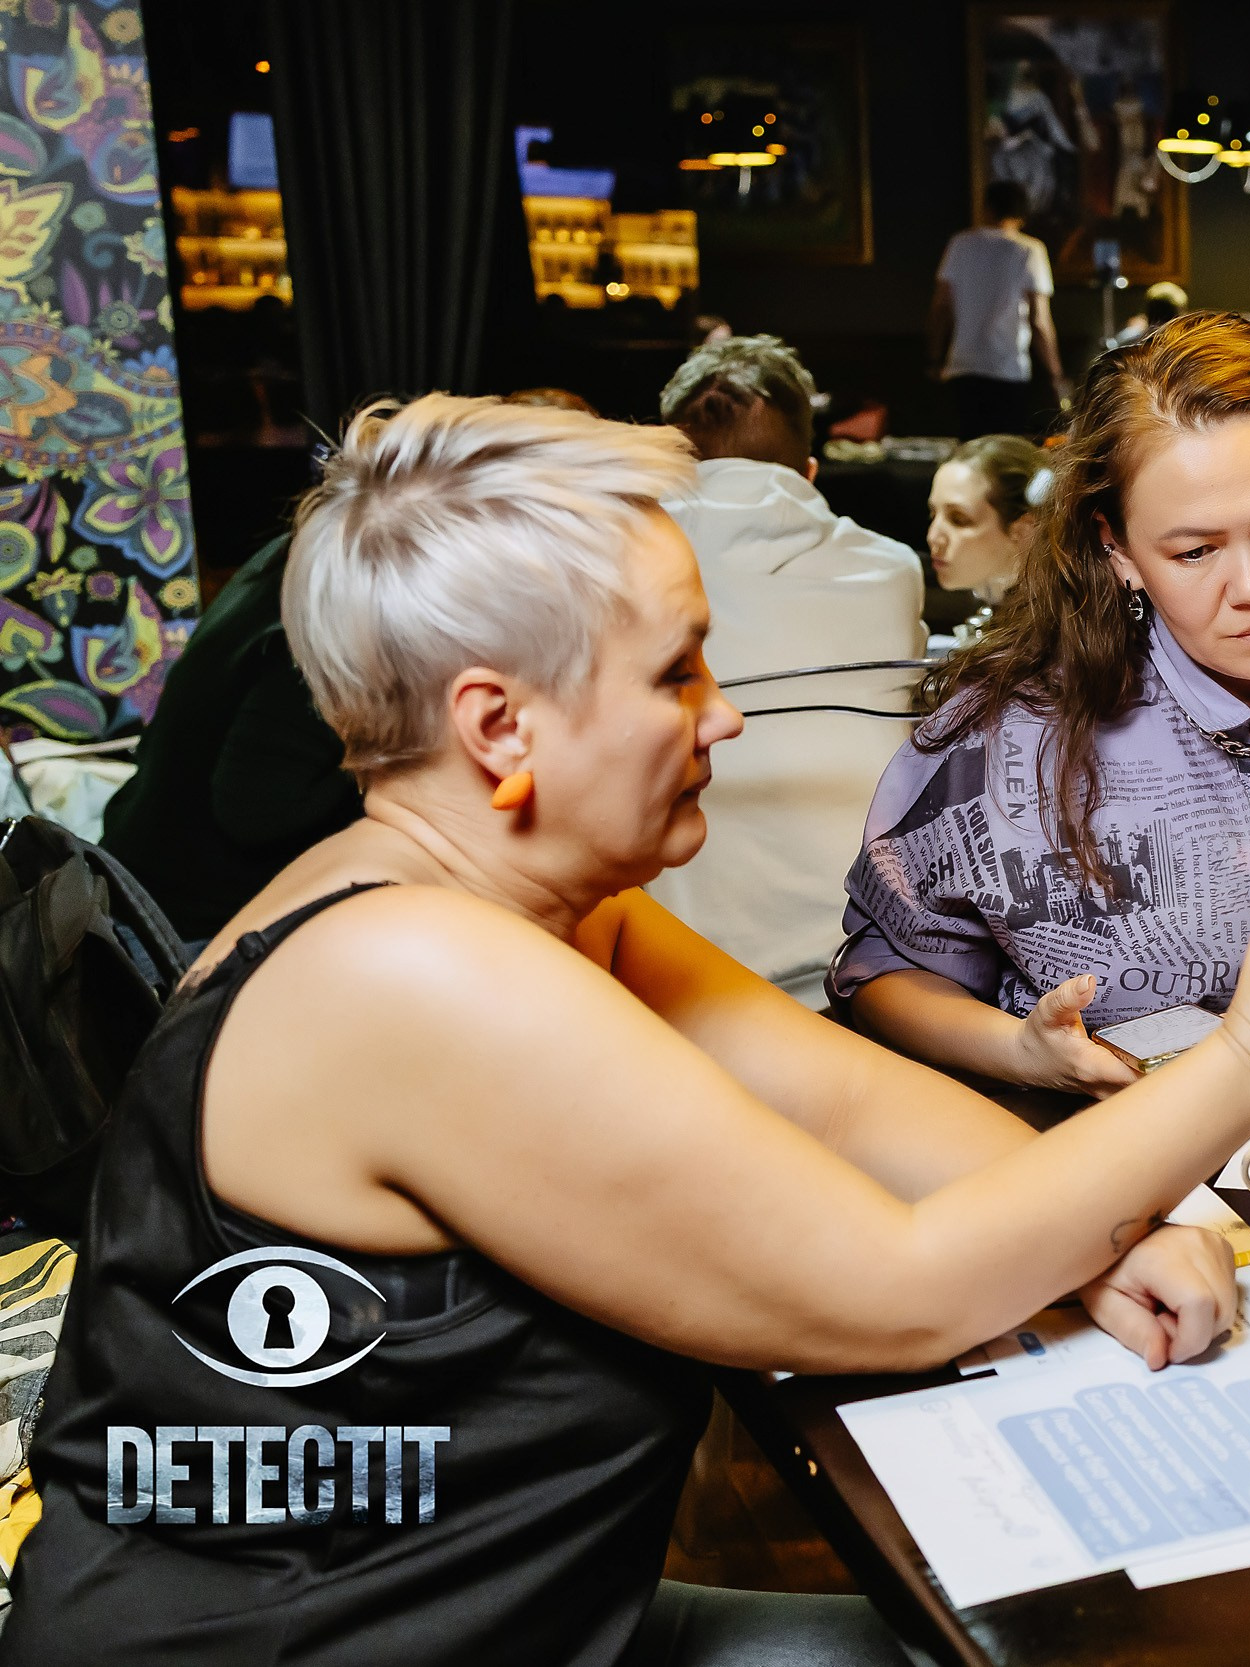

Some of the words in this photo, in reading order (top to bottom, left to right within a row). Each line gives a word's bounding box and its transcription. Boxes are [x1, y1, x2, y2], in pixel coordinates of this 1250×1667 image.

[1035, 932, 1046, 941] the
[1047, 936, 1066, 946] crash
[1059, 929, 1080, 940] police
[1020, 946, 1044, 958] nearby
[1045, 953, 1071, 966] hospital
[1036, 941, 1047, 950] for
[1048, 946, 1069, 956] minor
[1069, 950, 1095, 963] injuries
